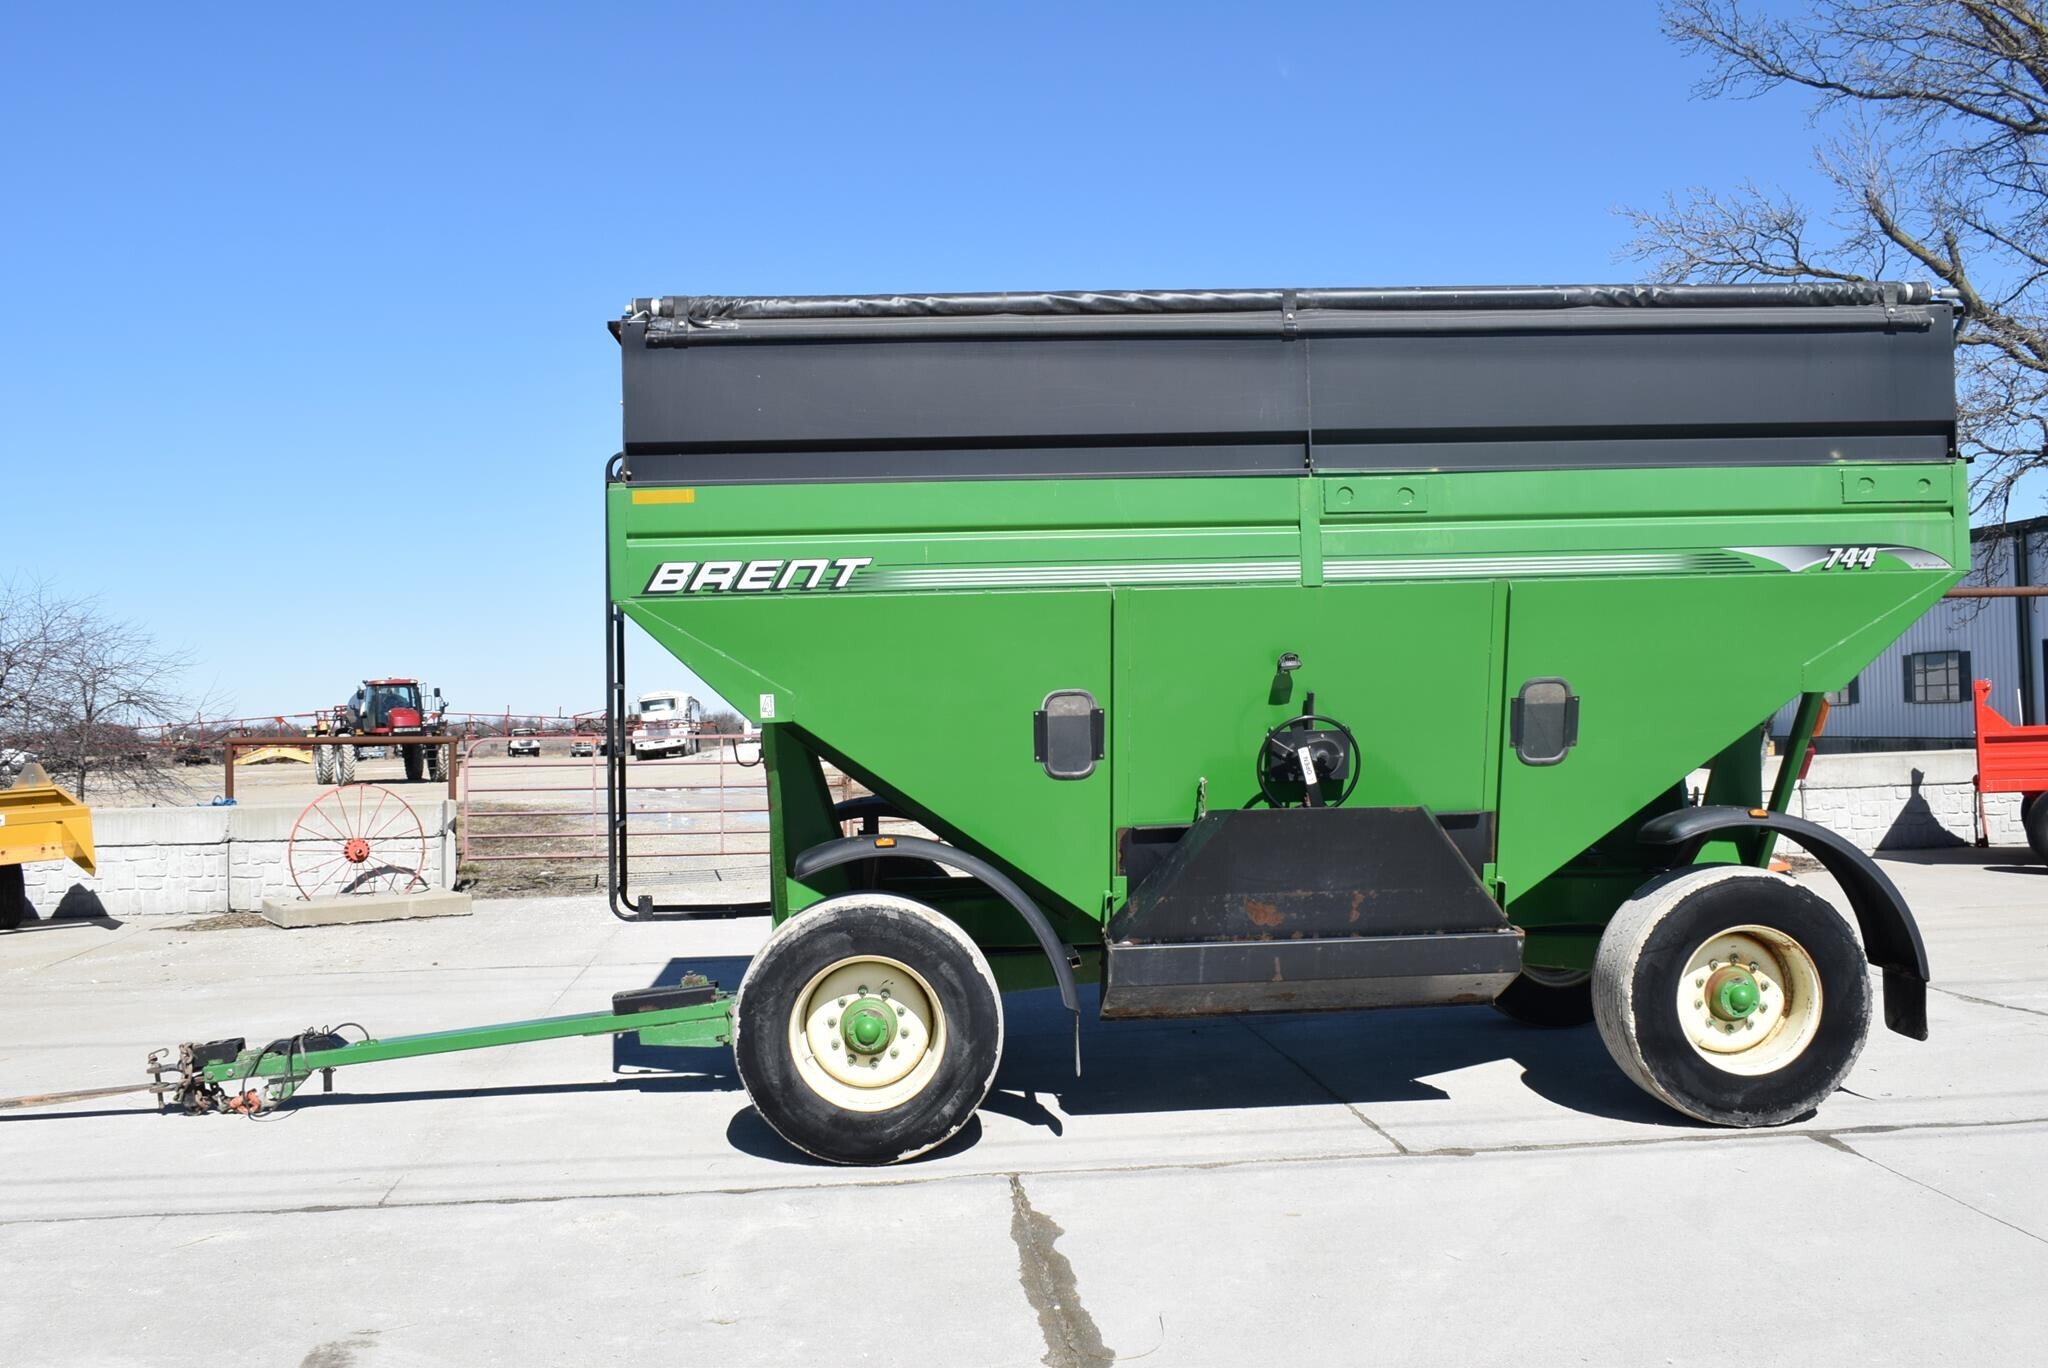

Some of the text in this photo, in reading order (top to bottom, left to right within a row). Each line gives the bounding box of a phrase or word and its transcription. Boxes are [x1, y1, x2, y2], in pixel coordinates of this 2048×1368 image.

[1822, 547, 1878, 570] 744
[642, 557, 873, 594] BRENT
[762, 695, 773, 716] 4
[1302, 756, 1313, 775] OPEN
